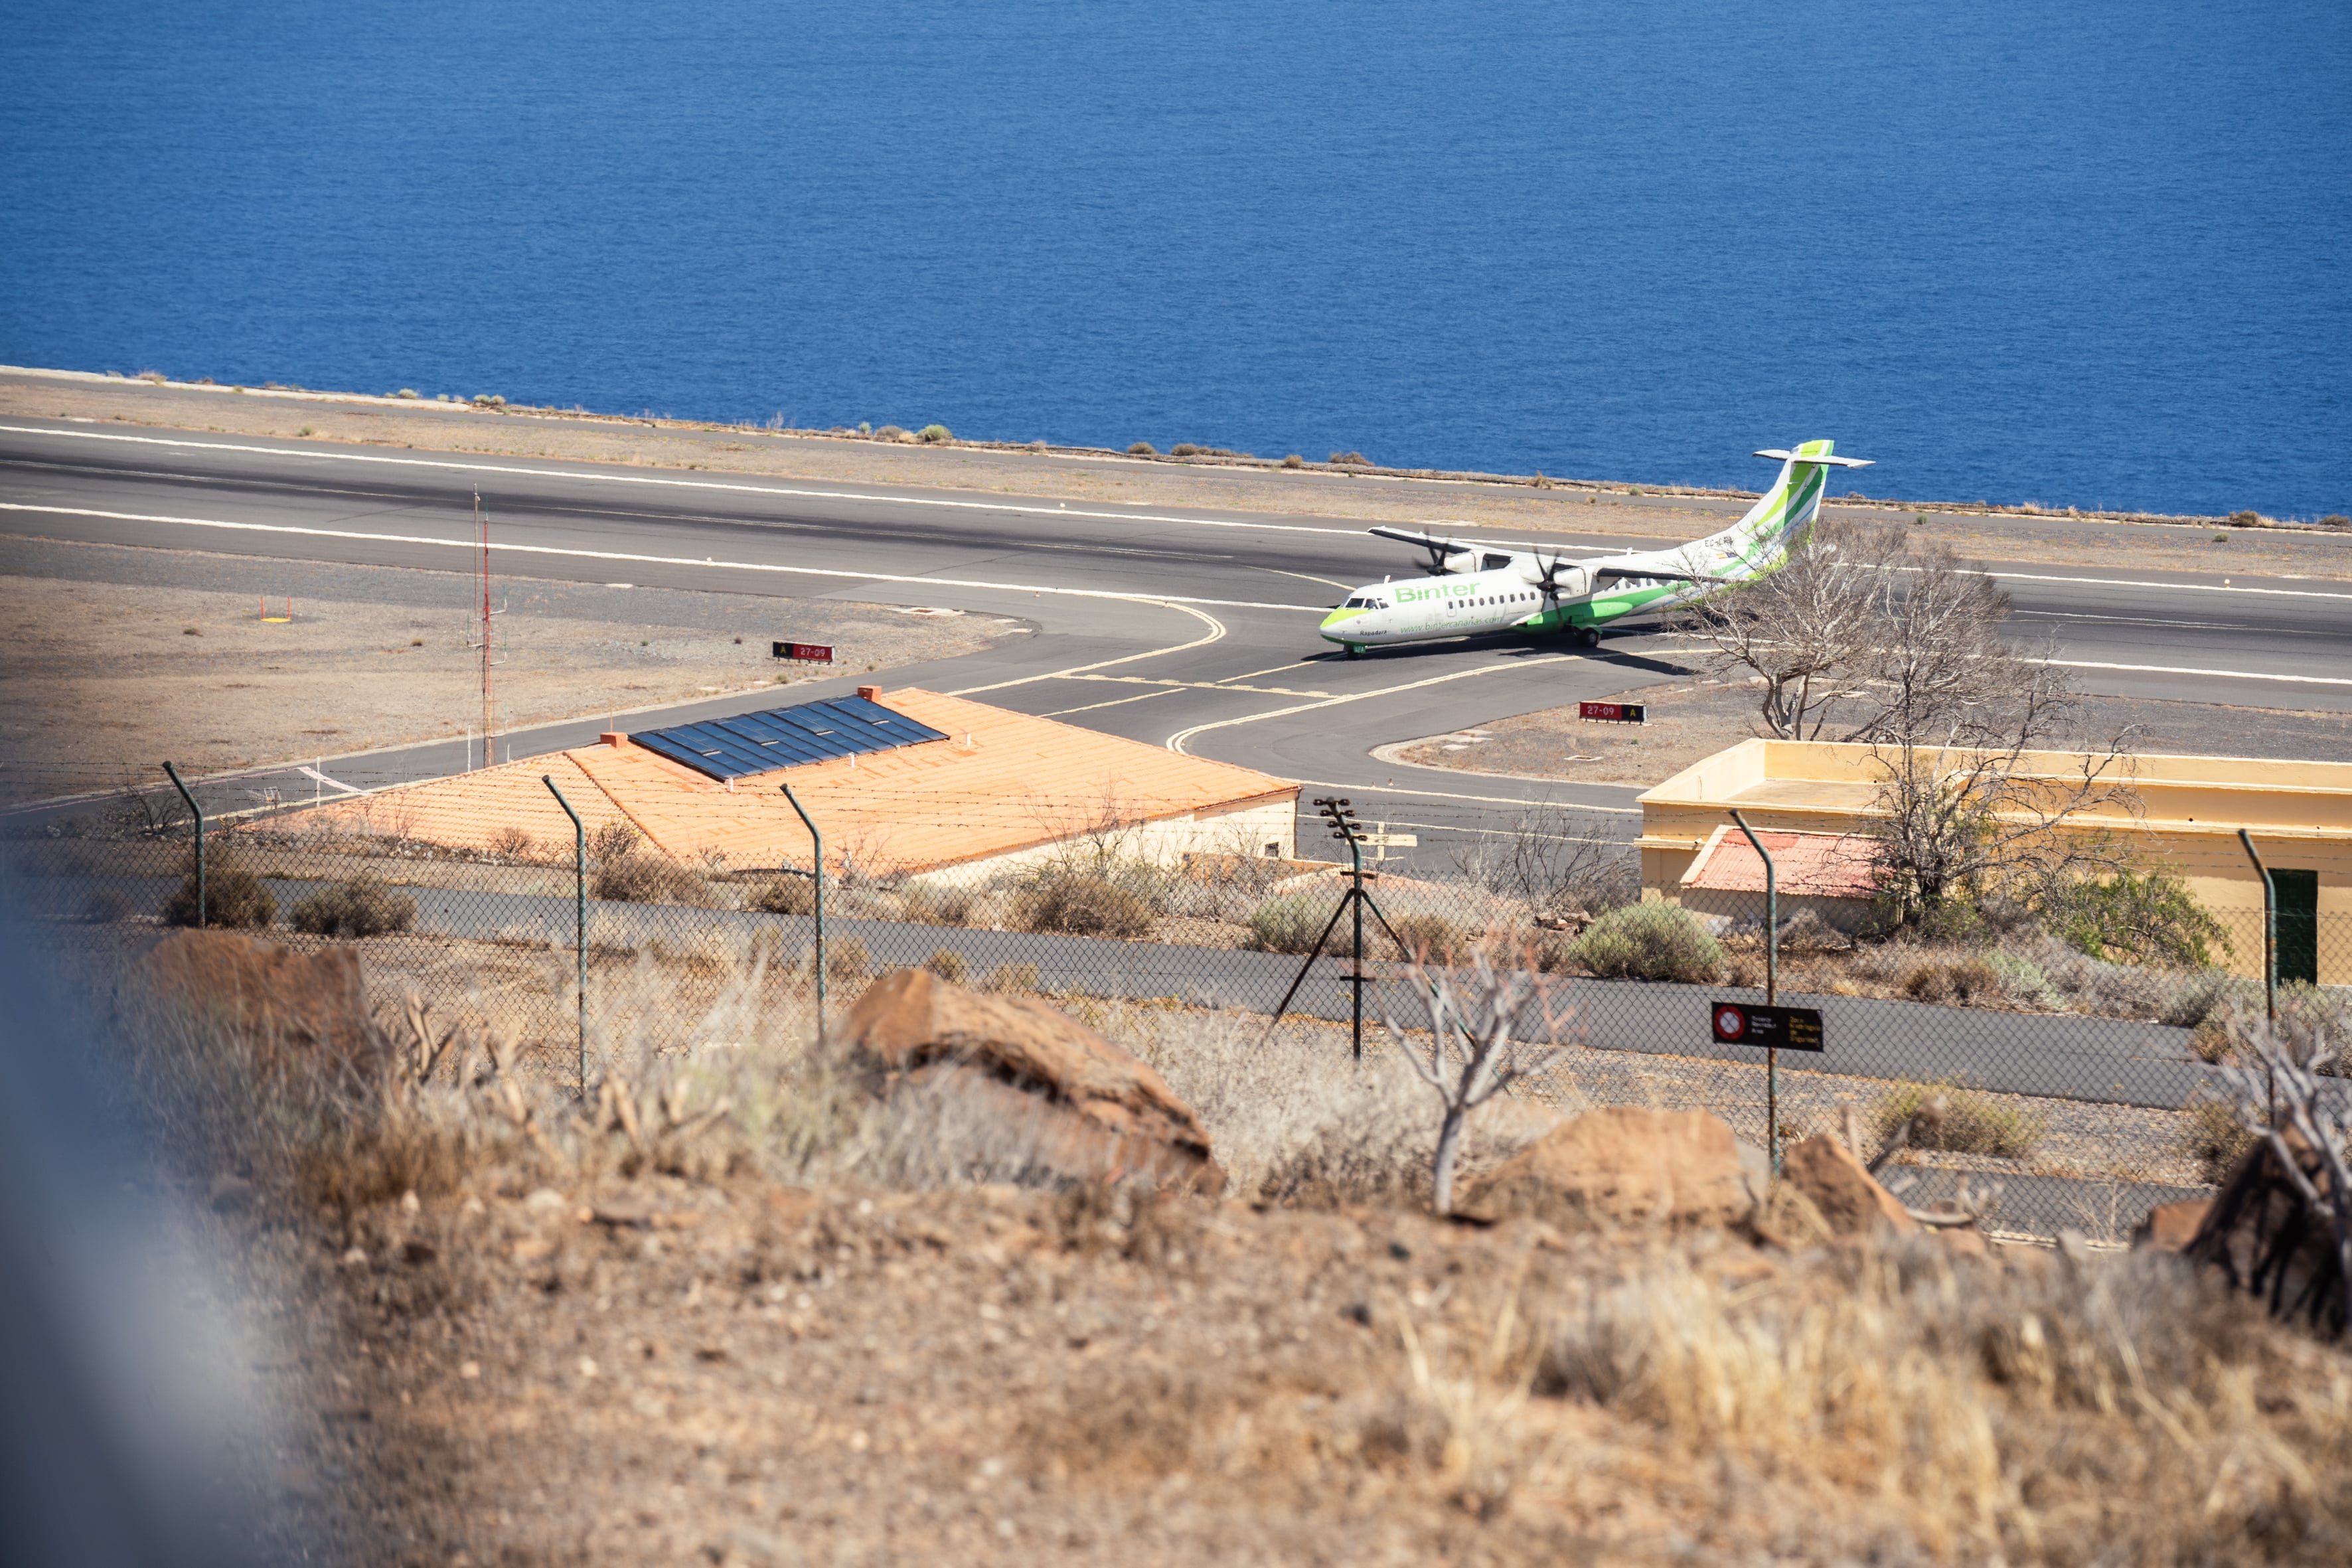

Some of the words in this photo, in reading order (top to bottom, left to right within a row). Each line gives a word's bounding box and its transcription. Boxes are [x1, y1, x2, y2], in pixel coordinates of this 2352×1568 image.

[1394, 582, 1481, 603] Binter
[1400, 616, 1503, 633] www.bintercanarias.com
[780, 645, 787, 654] A
[800, 647, 826, 657] 27-09
[1587, 705, 1615, 716] 27-09
[1630, 708, 1636, 717] A
